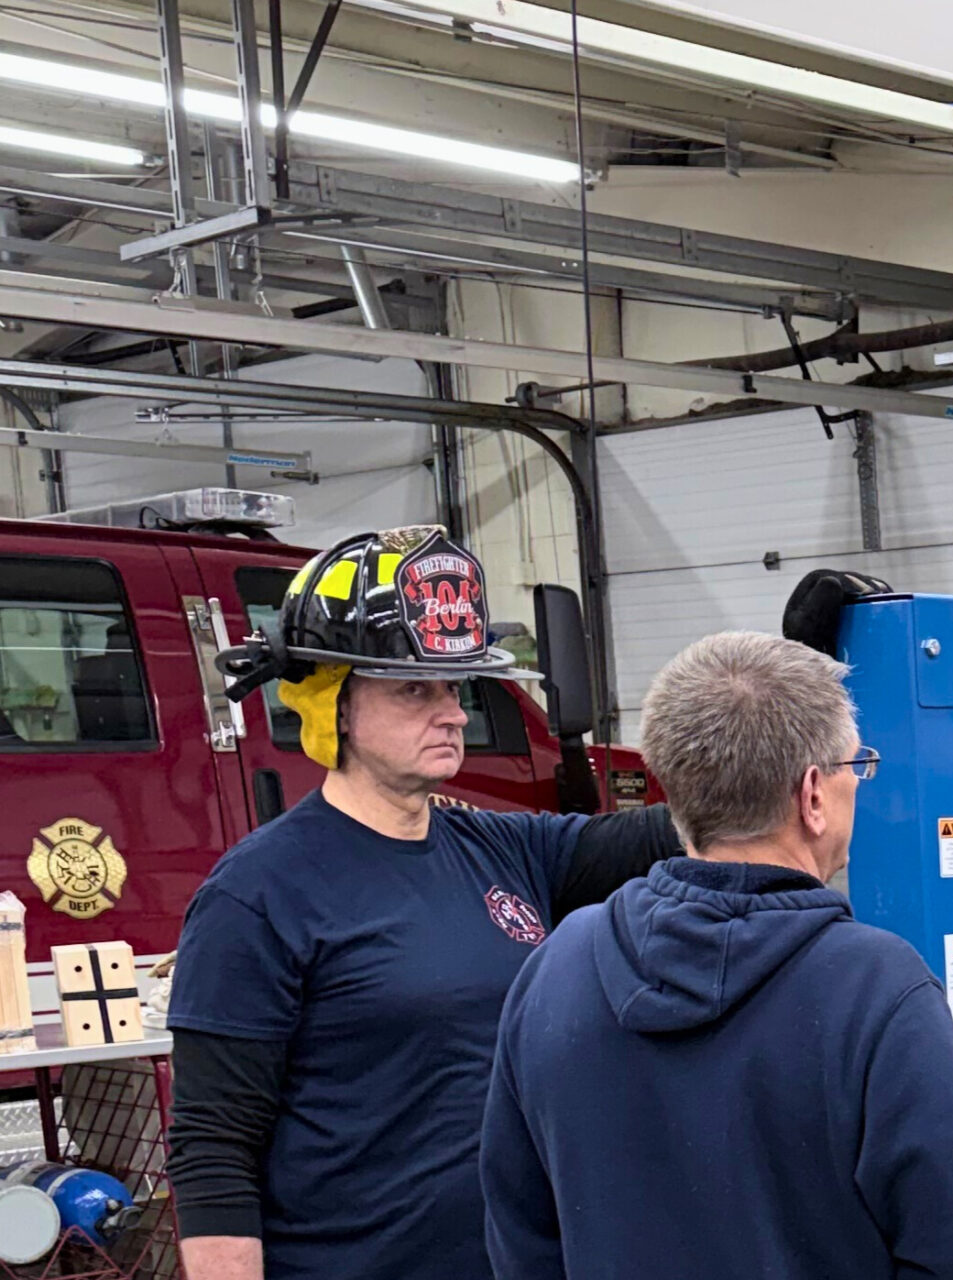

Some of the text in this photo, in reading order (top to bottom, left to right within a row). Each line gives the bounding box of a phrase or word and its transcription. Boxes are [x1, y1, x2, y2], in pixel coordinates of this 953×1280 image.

[413, 555, 470, 580] FIREFIGHTER
[420, 580, 476, 631] 104
[420, 595, 475, 616] Berlin
[59, 825, 84, 836] FIRE
